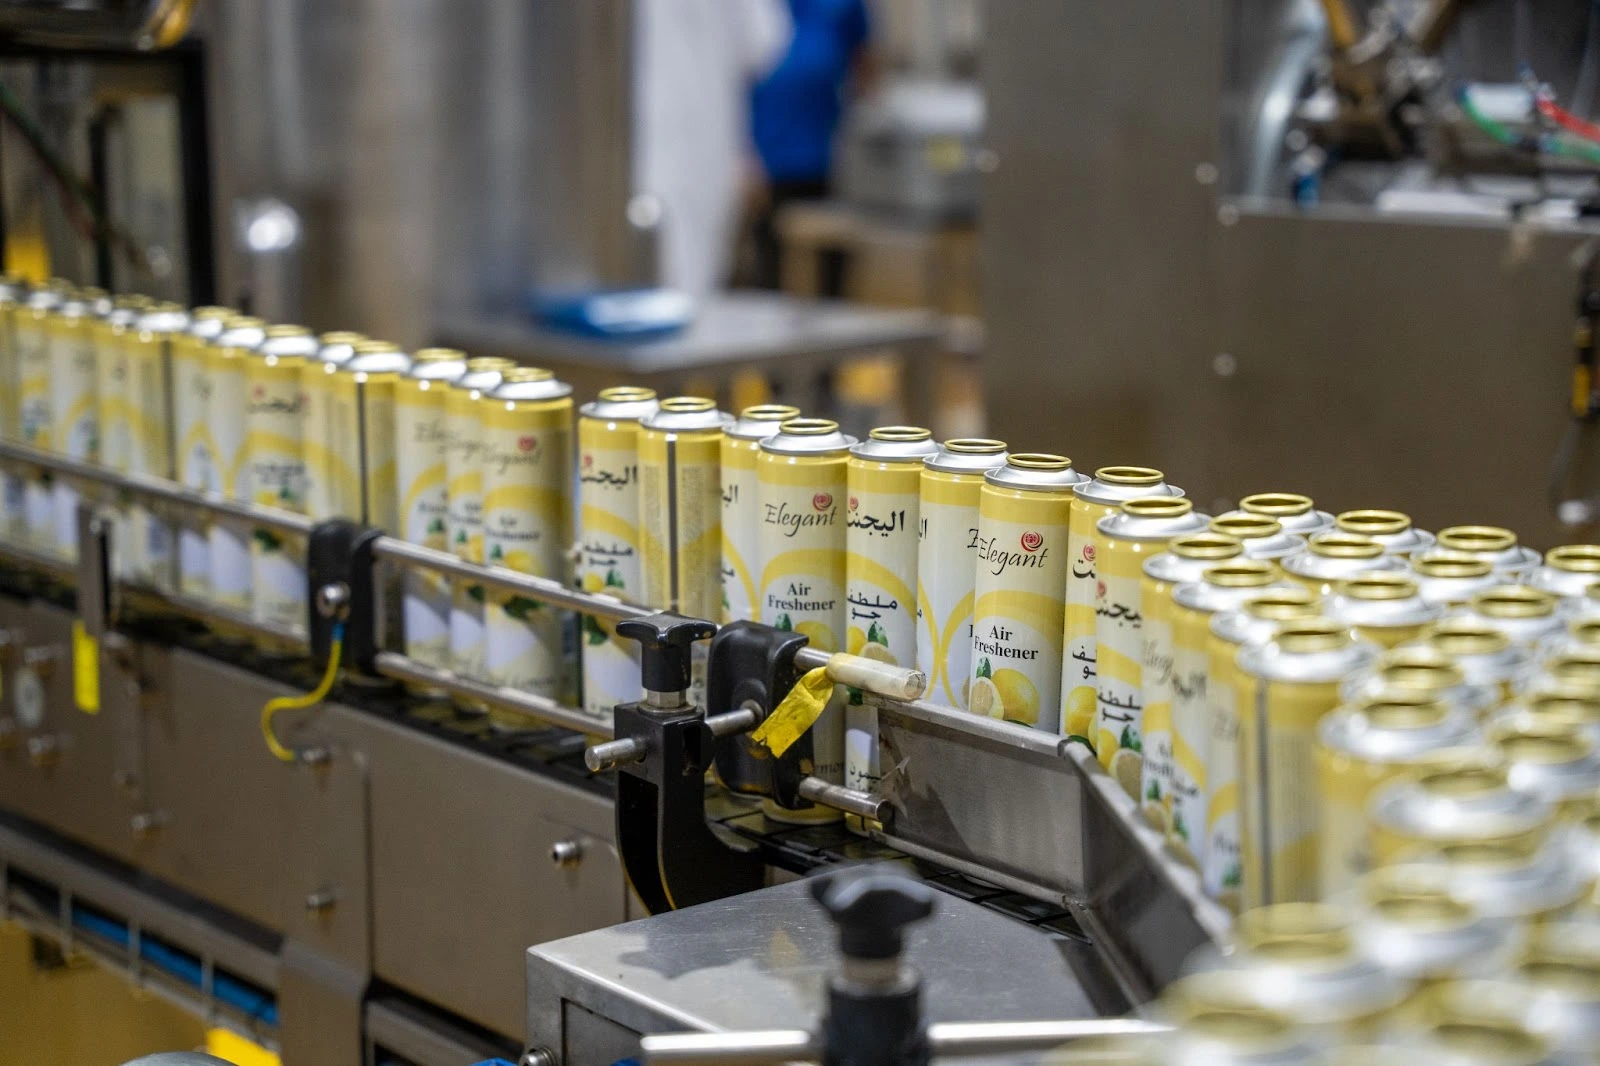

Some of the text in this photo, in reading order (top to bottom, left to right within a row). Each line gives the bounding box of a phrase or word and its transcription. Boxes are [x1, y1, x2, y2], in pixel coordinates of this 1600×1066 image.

[765, 502, 837, 537] Elegant
[978, 537, 1049, 575] Elegant
[787, 582, 811, 596] Air
[768, 595, 836, 611] Freshener
[989, 625, 1013, 641] Air
[974, 635, 1039, 660] Freshener
